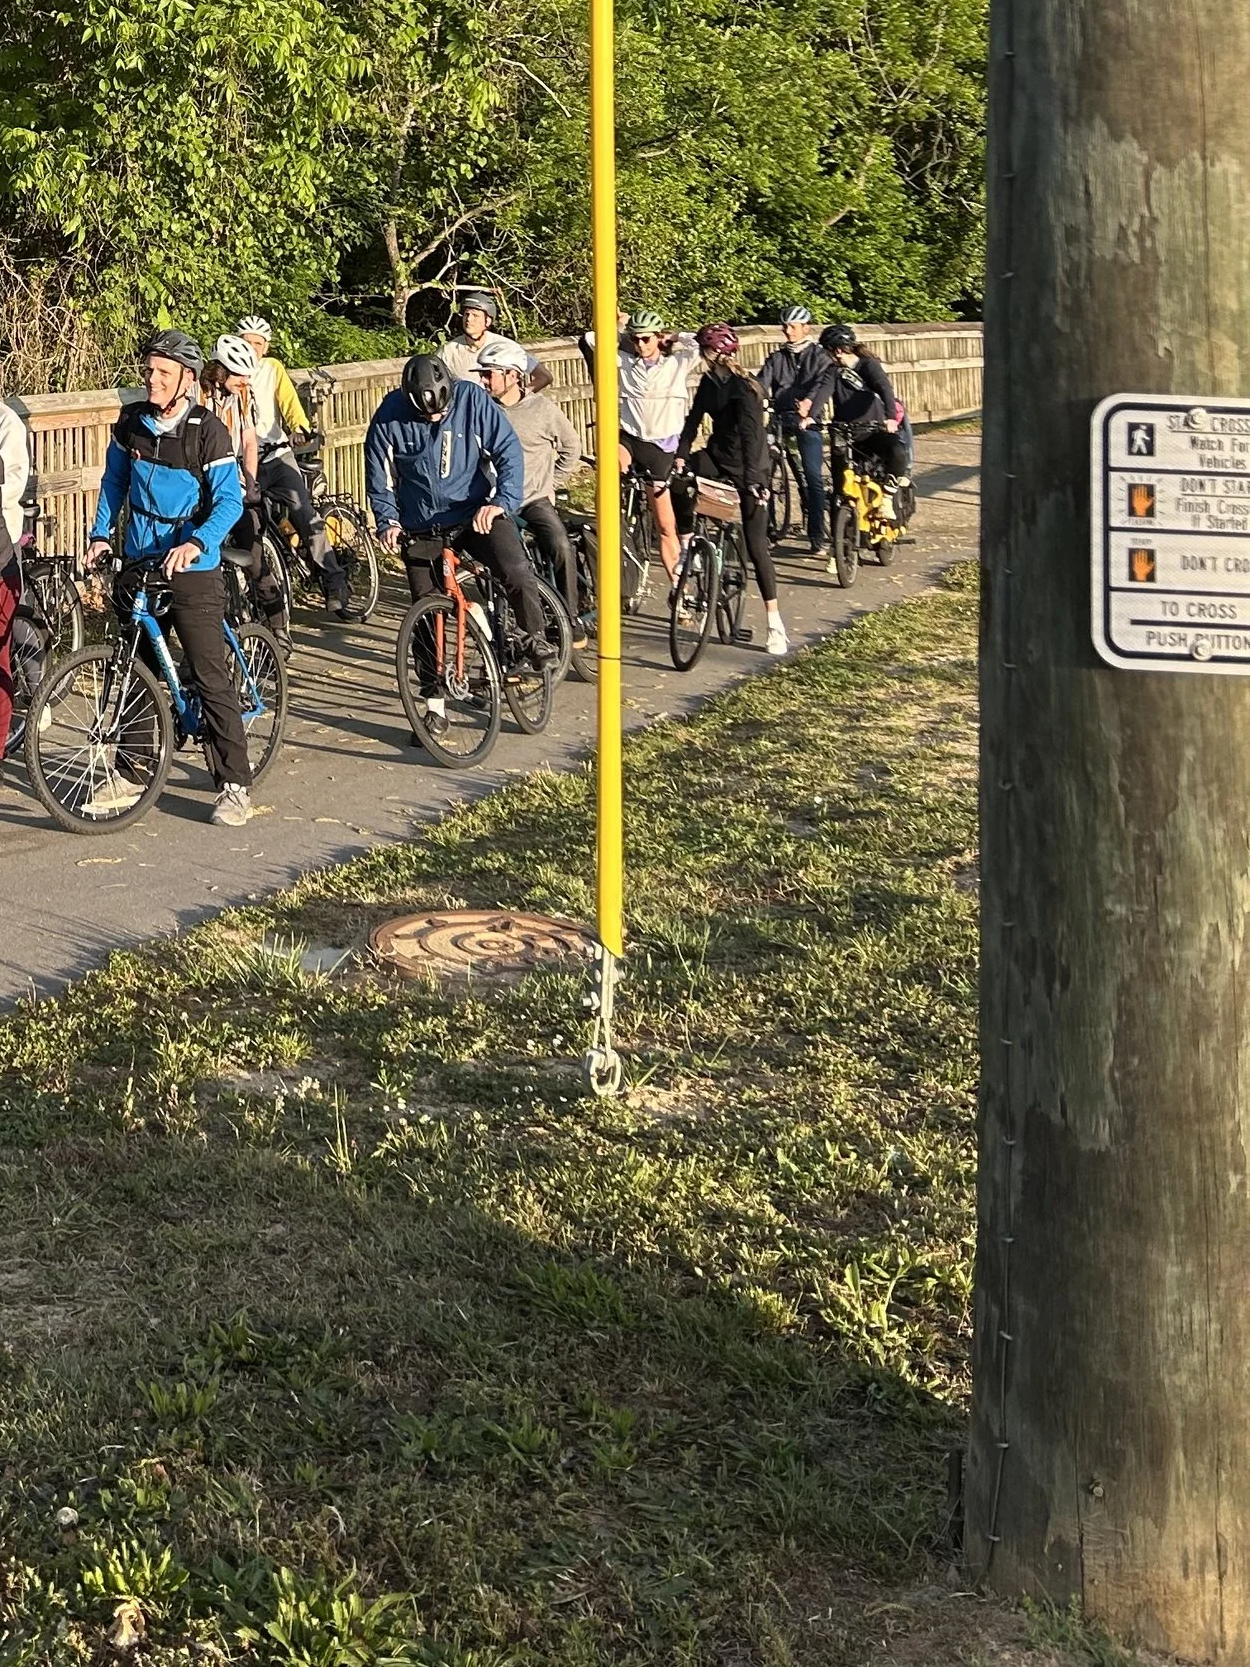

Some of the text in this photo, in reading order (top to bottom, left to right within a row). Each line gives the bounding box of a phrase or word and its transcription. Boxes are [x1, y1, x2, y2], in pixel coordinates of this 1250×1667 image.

[1190, 435, 1225, 451] Watch
[1199, 454, 1247, 470] Vehicles
[1174, 497, 1211, 514] Finish
[1206, 515, 1248, 531] Started
[1181, 555, 1218, 573] DON'T
[1161, 600, 1238, 620] TO CROSS
[1145, 630, 1188, 648] PUSH
